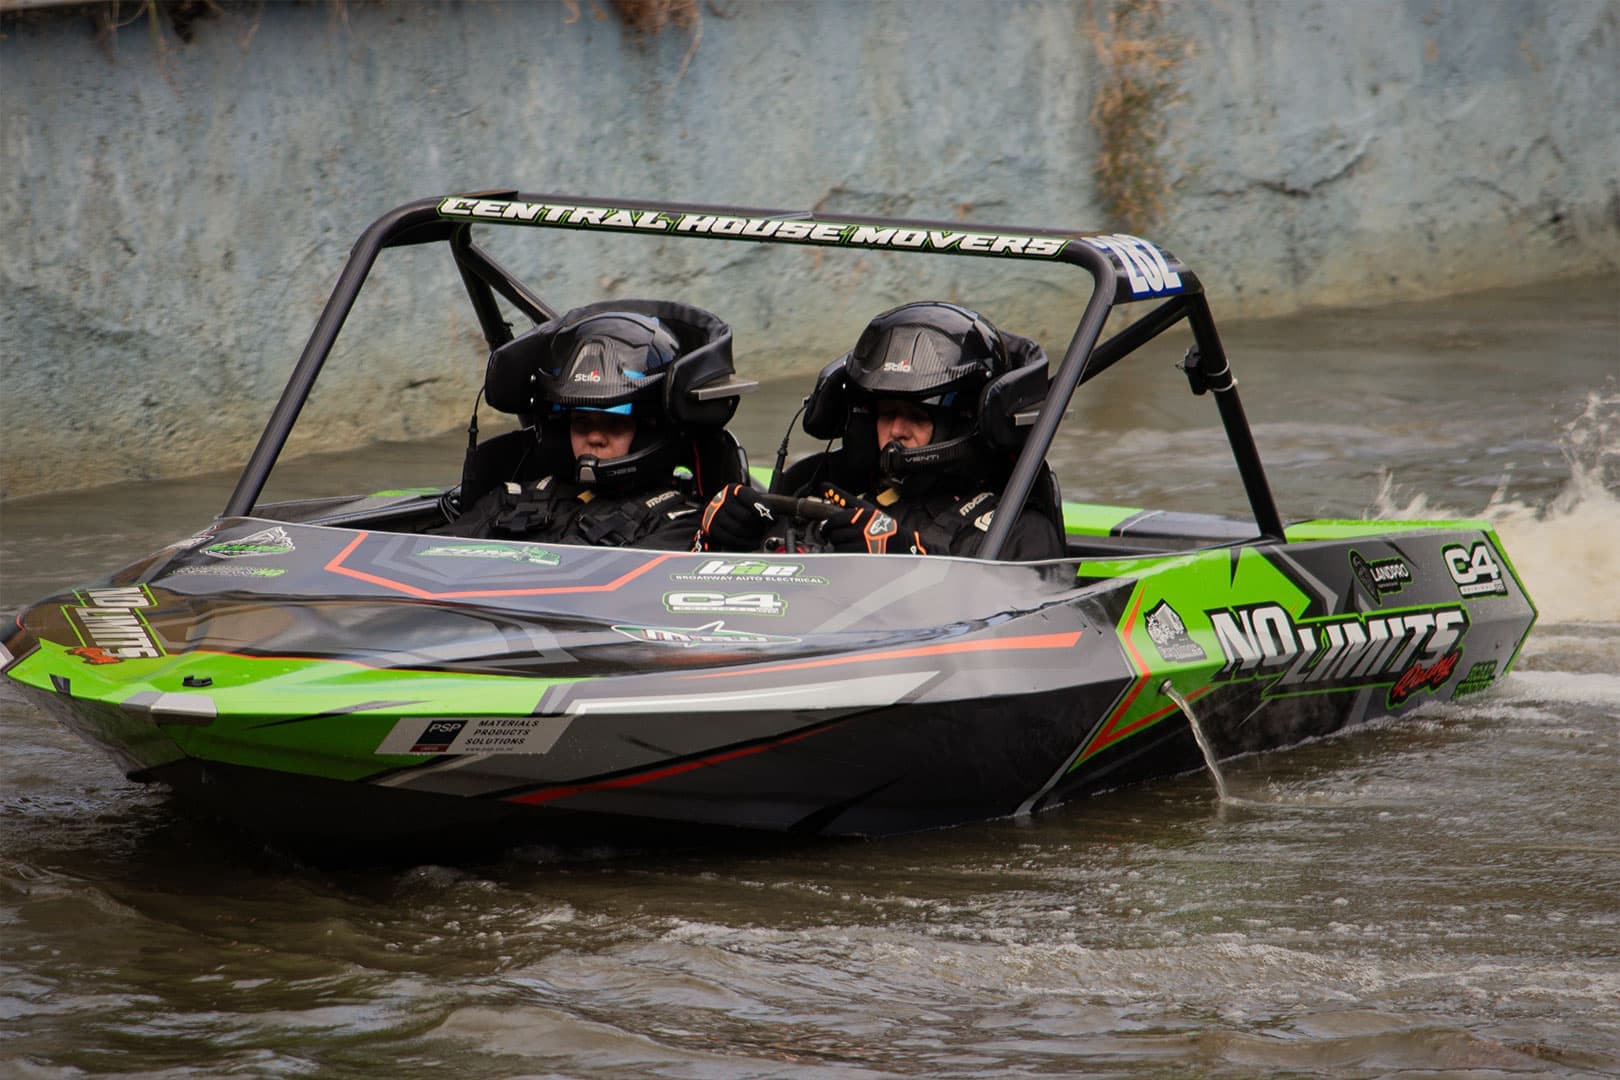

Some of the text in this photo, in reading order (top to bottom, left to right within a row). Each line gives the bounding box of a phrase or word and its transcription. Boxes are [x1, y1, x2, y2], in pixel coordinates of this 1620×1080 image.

[440, 198, 1066, 256] CENTRAL HOUSE MOVERS
[883, 360, 911, 373] Stilo
[574, 370, 601, 382] Stilo
[1369, 563, 1409, 582] LANDPRO
[1444, 545, 1499, 584] C4
[86, 587, 149, 606] NO
[668, 593, 782, 608] C4
[75, 608, 159, 657] LIMITS
[1210, 605, 1465, 687] NO LIMITS
[428, 723, 461, 733] PSP
[479, 719, 540, 727] MATERIALS
[473, 728, 531, 736] PRODUCTS
